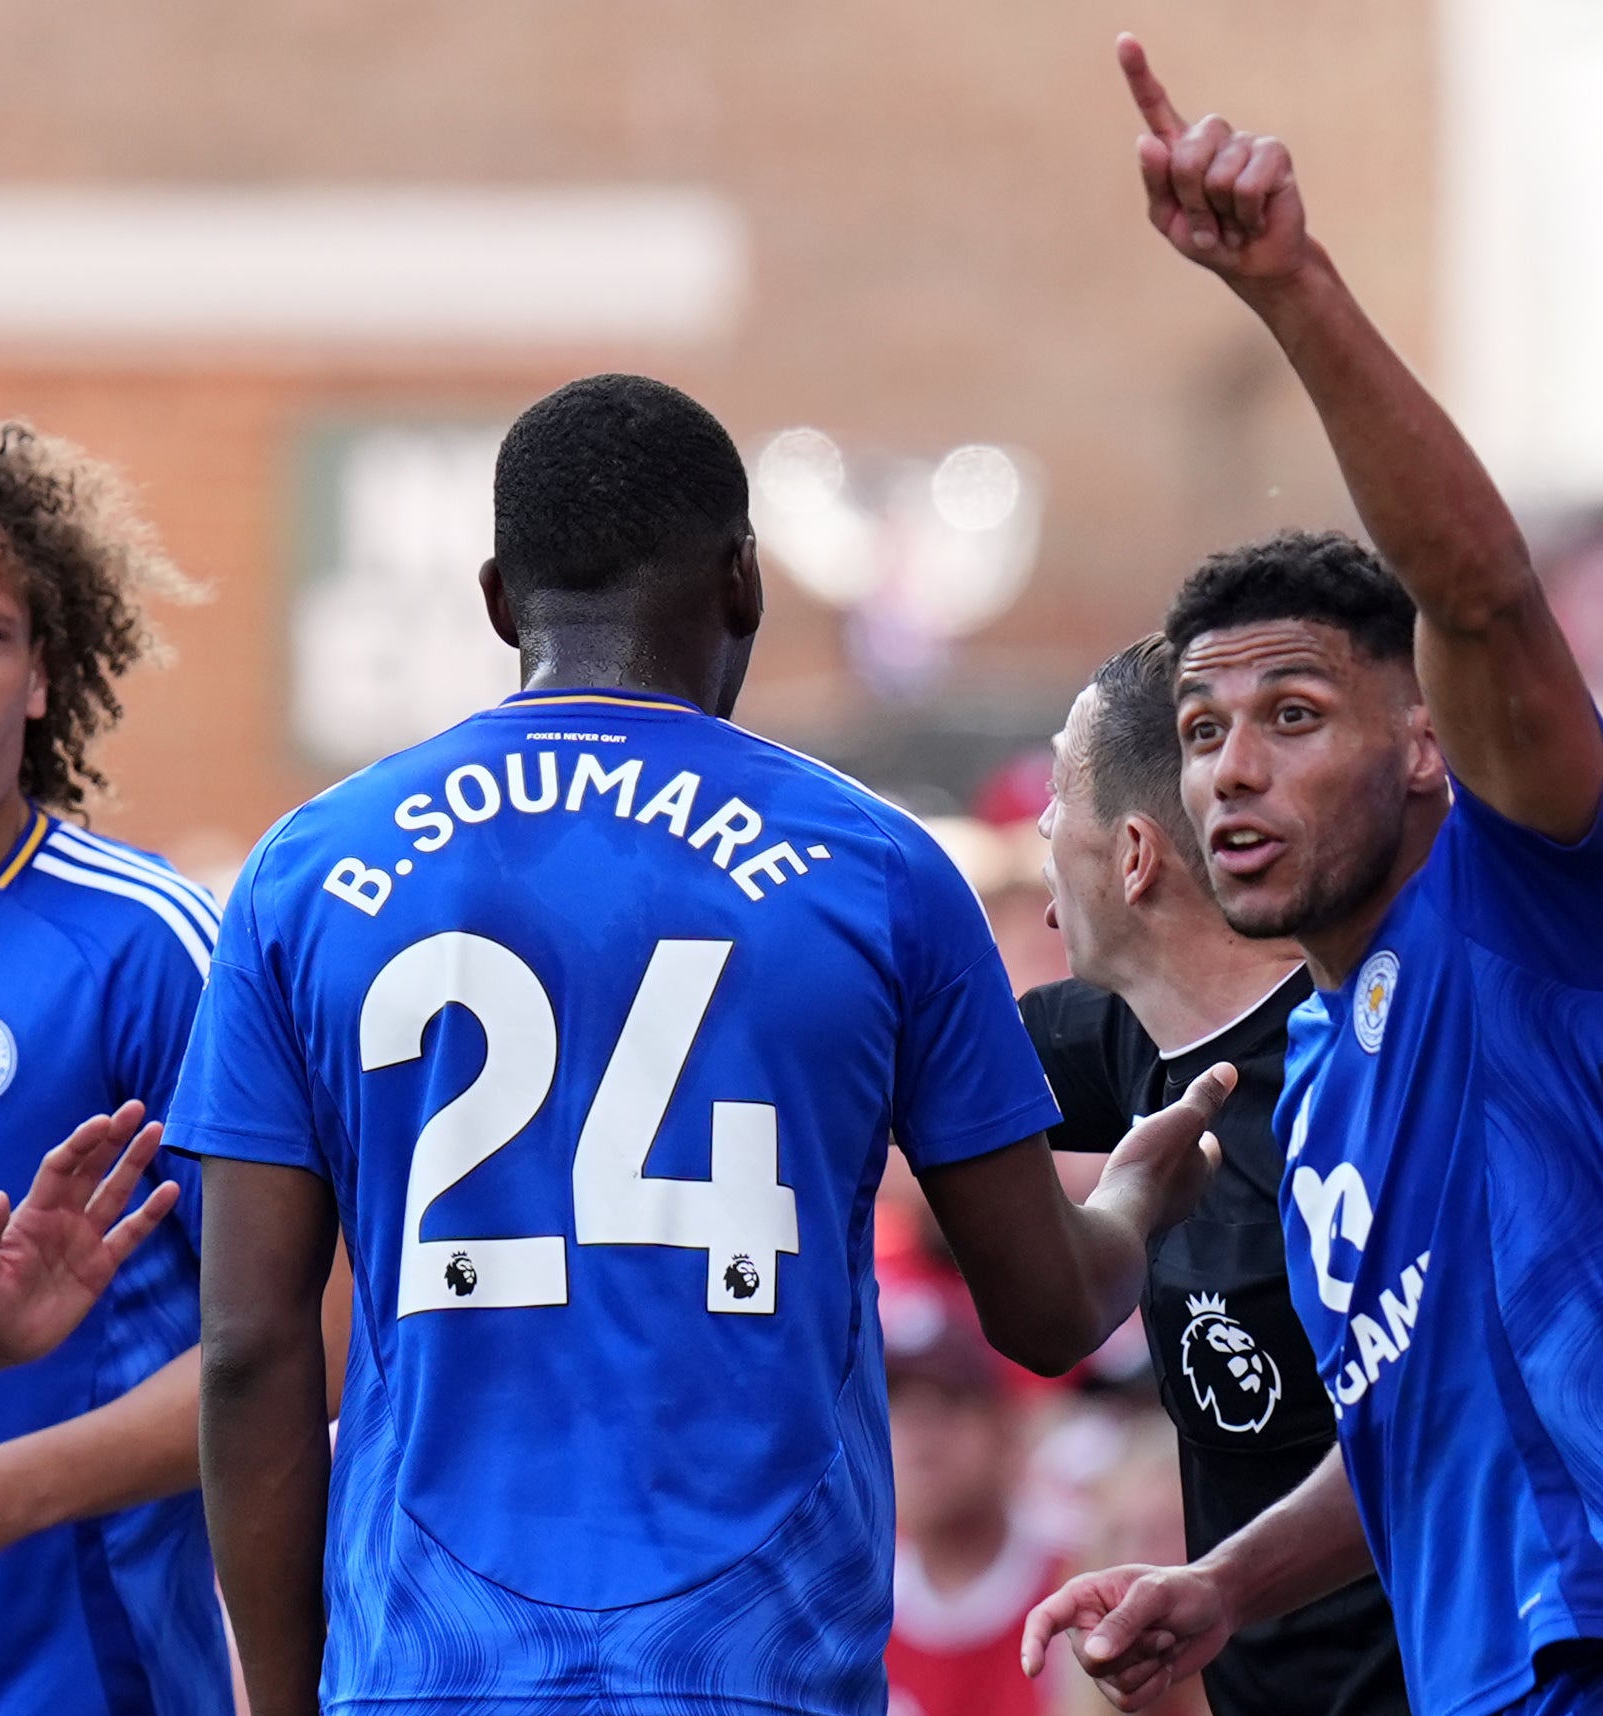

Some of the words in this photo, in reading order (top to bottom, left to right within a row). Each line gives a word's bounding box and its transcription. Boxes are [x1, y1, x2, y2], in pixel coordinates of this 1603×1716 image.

[526, 732, 562, 740] FOXES
[563, 733, 599, 742] NEVER
[600, 734, 627, 743] QUIT
[359, 930, 800, 1320] 24
